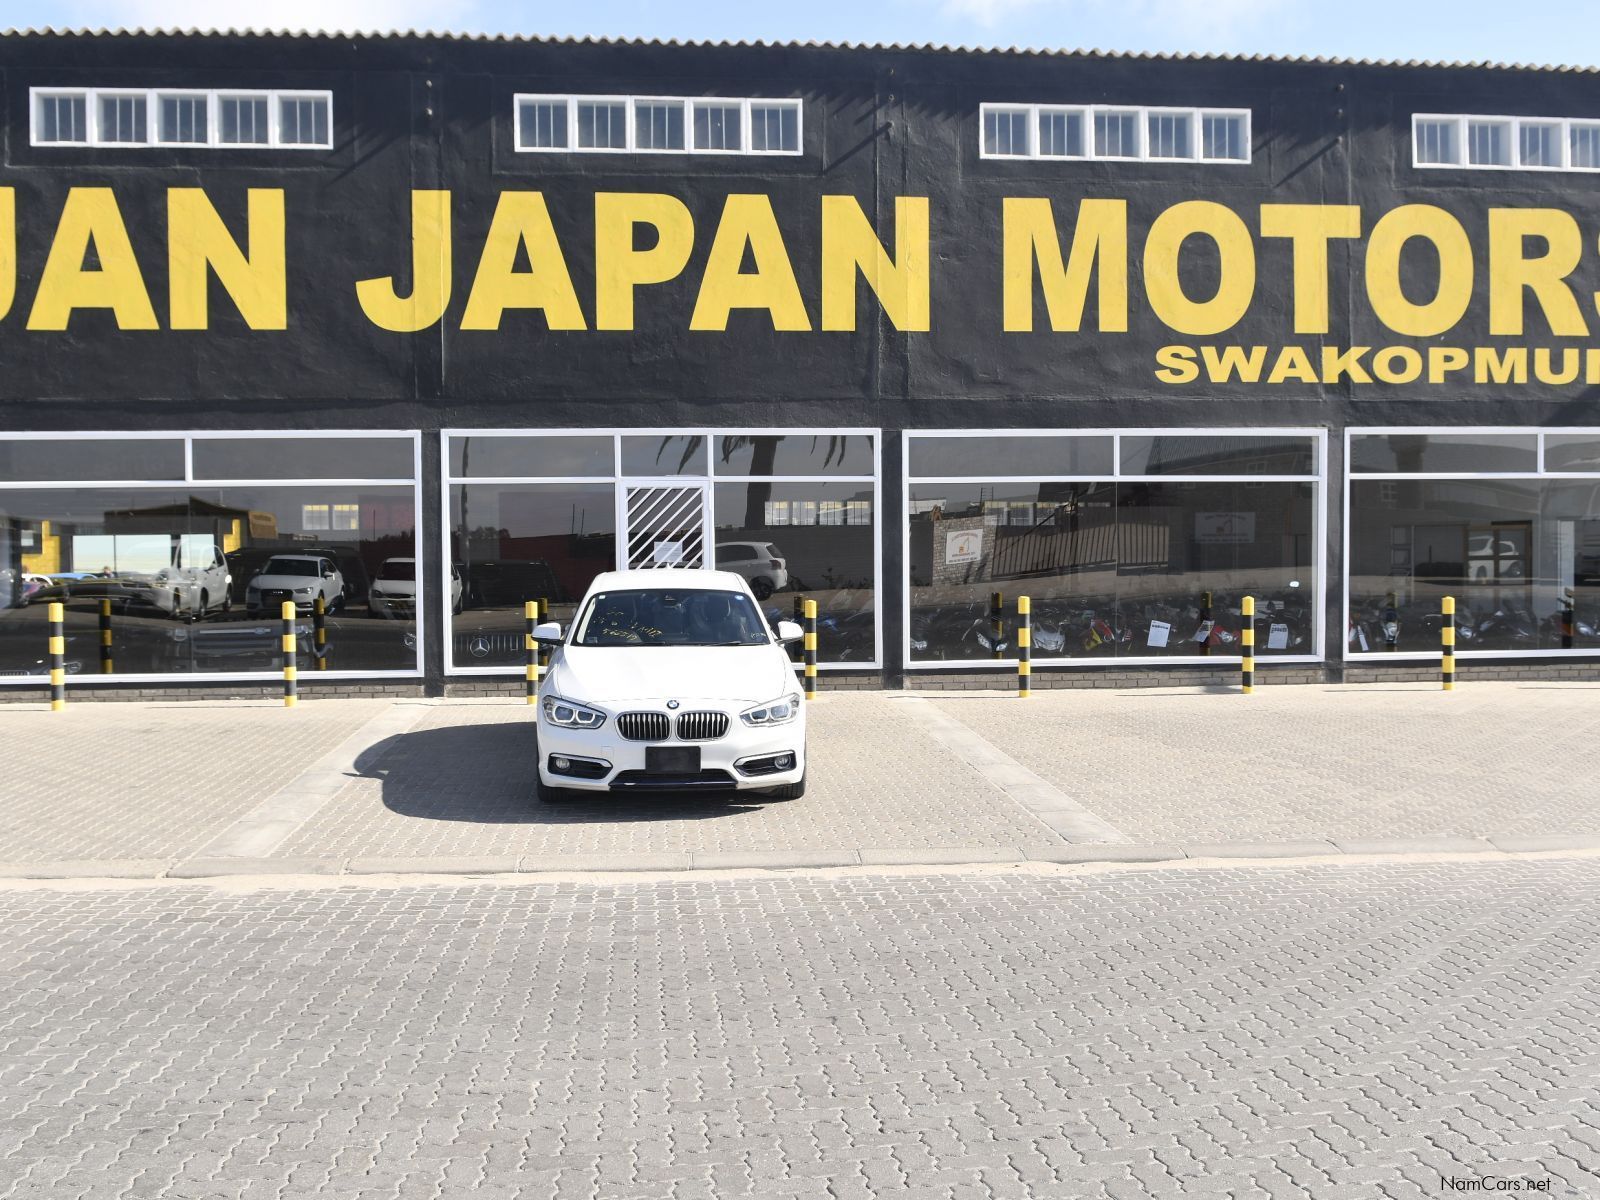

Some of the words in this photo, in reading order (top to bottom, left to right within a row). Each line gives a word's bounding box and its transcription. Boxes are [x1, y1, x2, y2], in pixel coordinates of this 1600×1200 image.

[0, 187, 288, 332] AN
[356, 190, 931, 333] JAPAN
[1002, 194, 1600, 338] MOTOR
[1154, 345, 1600, 386] SWAKOPMU
